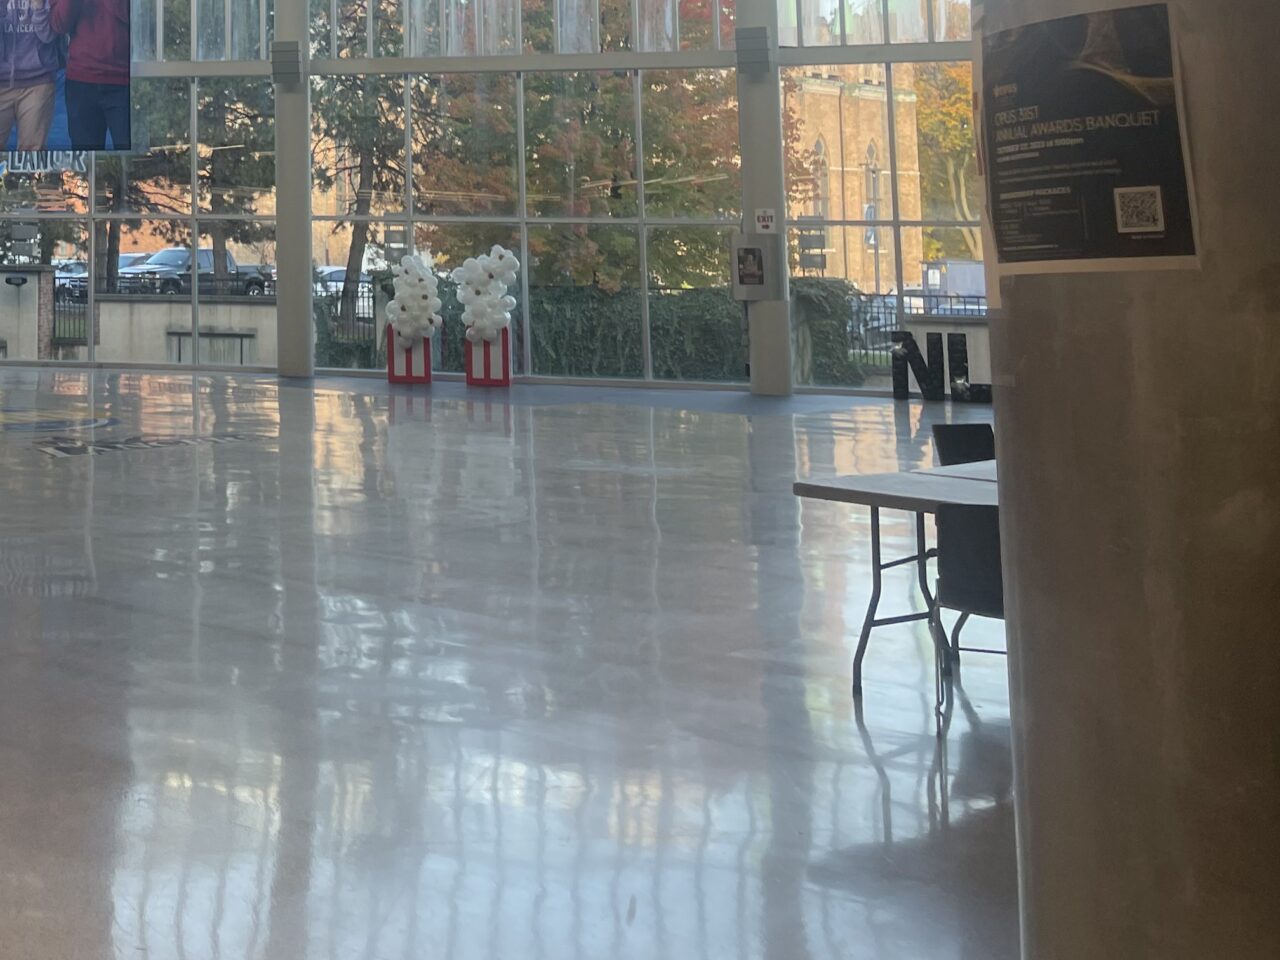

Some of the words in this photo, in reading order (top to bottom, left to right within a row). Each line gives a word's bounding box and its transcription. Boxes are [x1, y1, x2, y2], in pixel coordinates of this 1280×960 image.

[1030, 117, 1082, 136] AWARDS
[1085, 109, 1160, 131] BANQUET
[756, 215, 774, 224] EXIT
